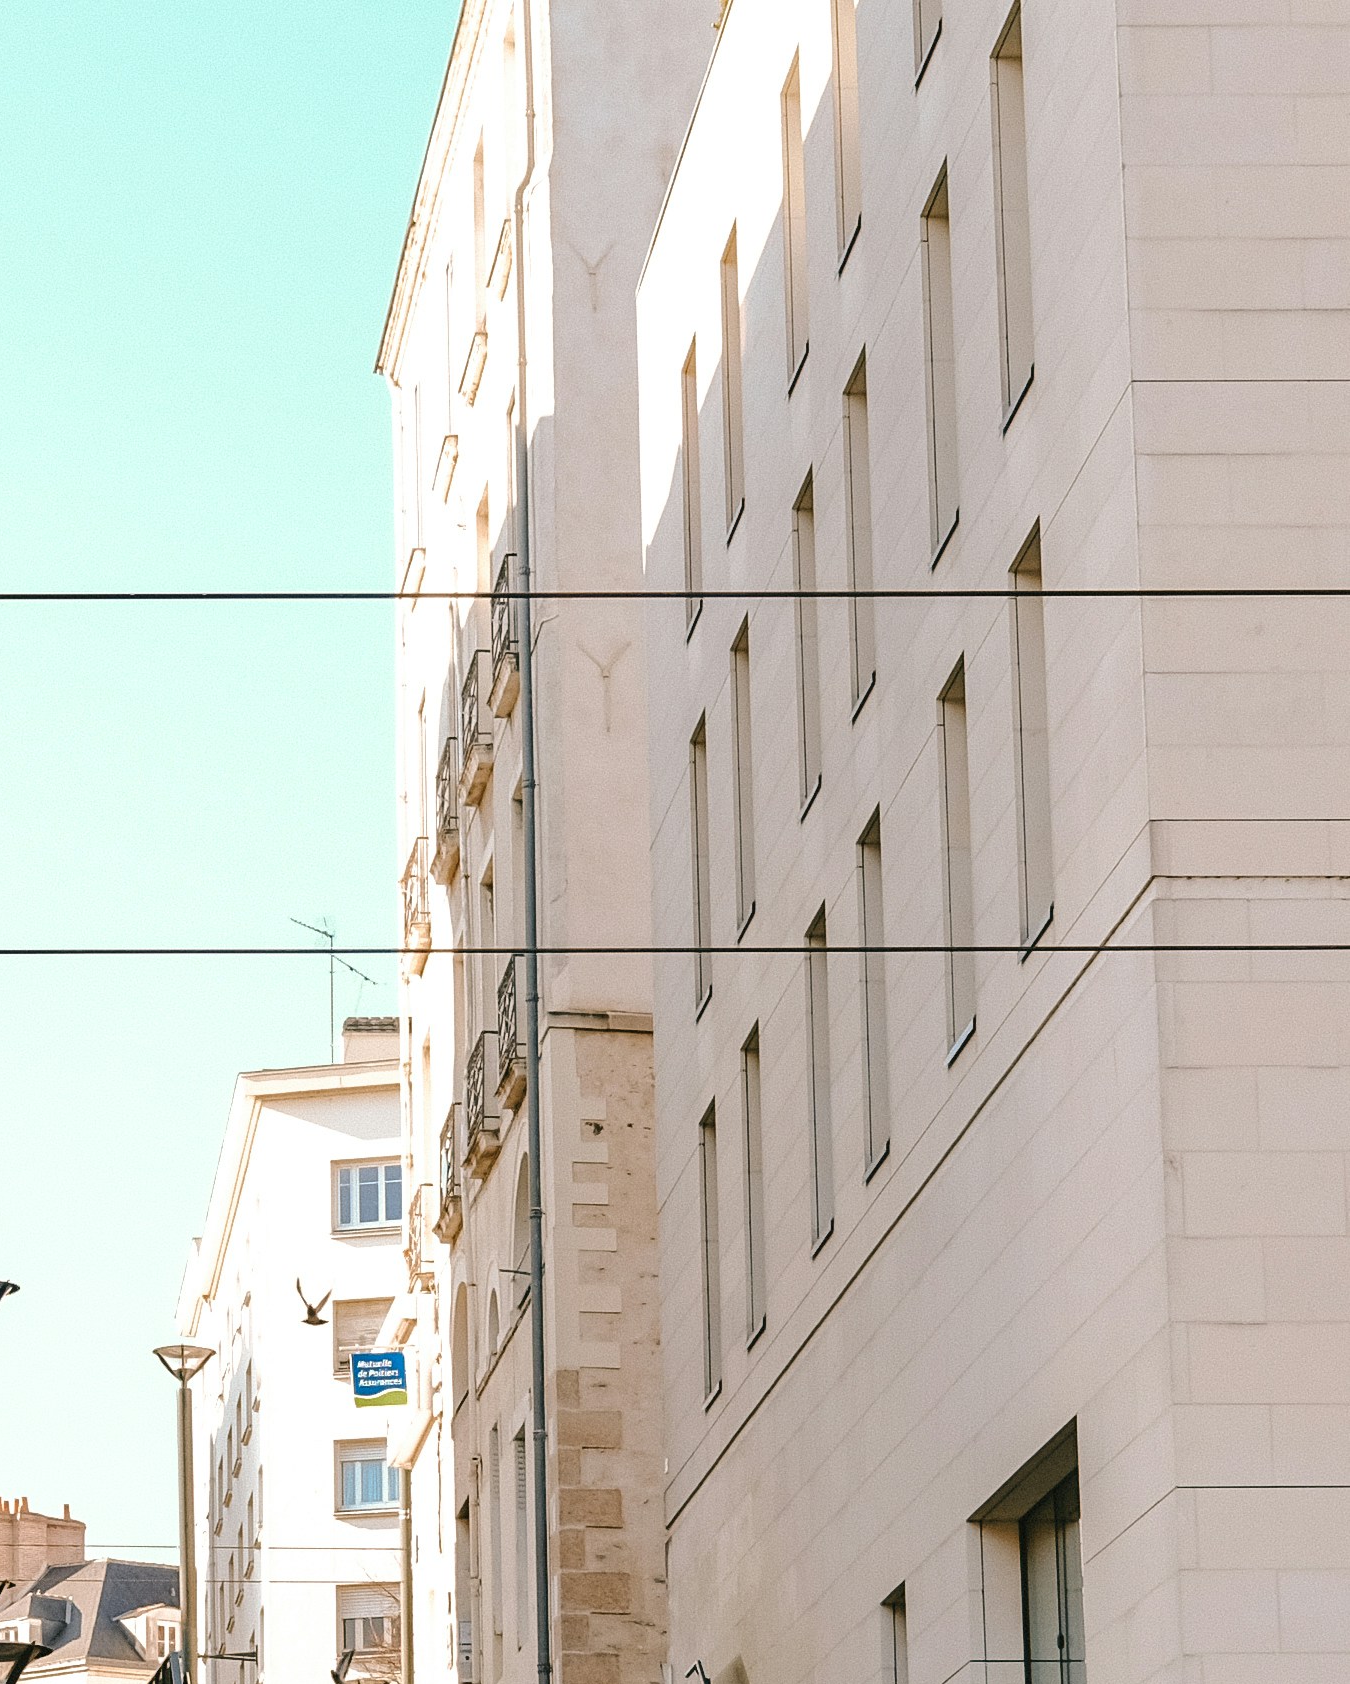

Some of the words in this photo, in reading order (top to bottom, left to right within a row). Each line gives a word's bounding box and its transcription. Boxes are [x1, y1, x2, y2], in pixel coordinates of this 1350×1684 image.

[357, 1359, 392, 1368] Mutuelle
[369, 1368, 399, 1377] Poitiers
[359, 1378, 402, 1387] Assurances
